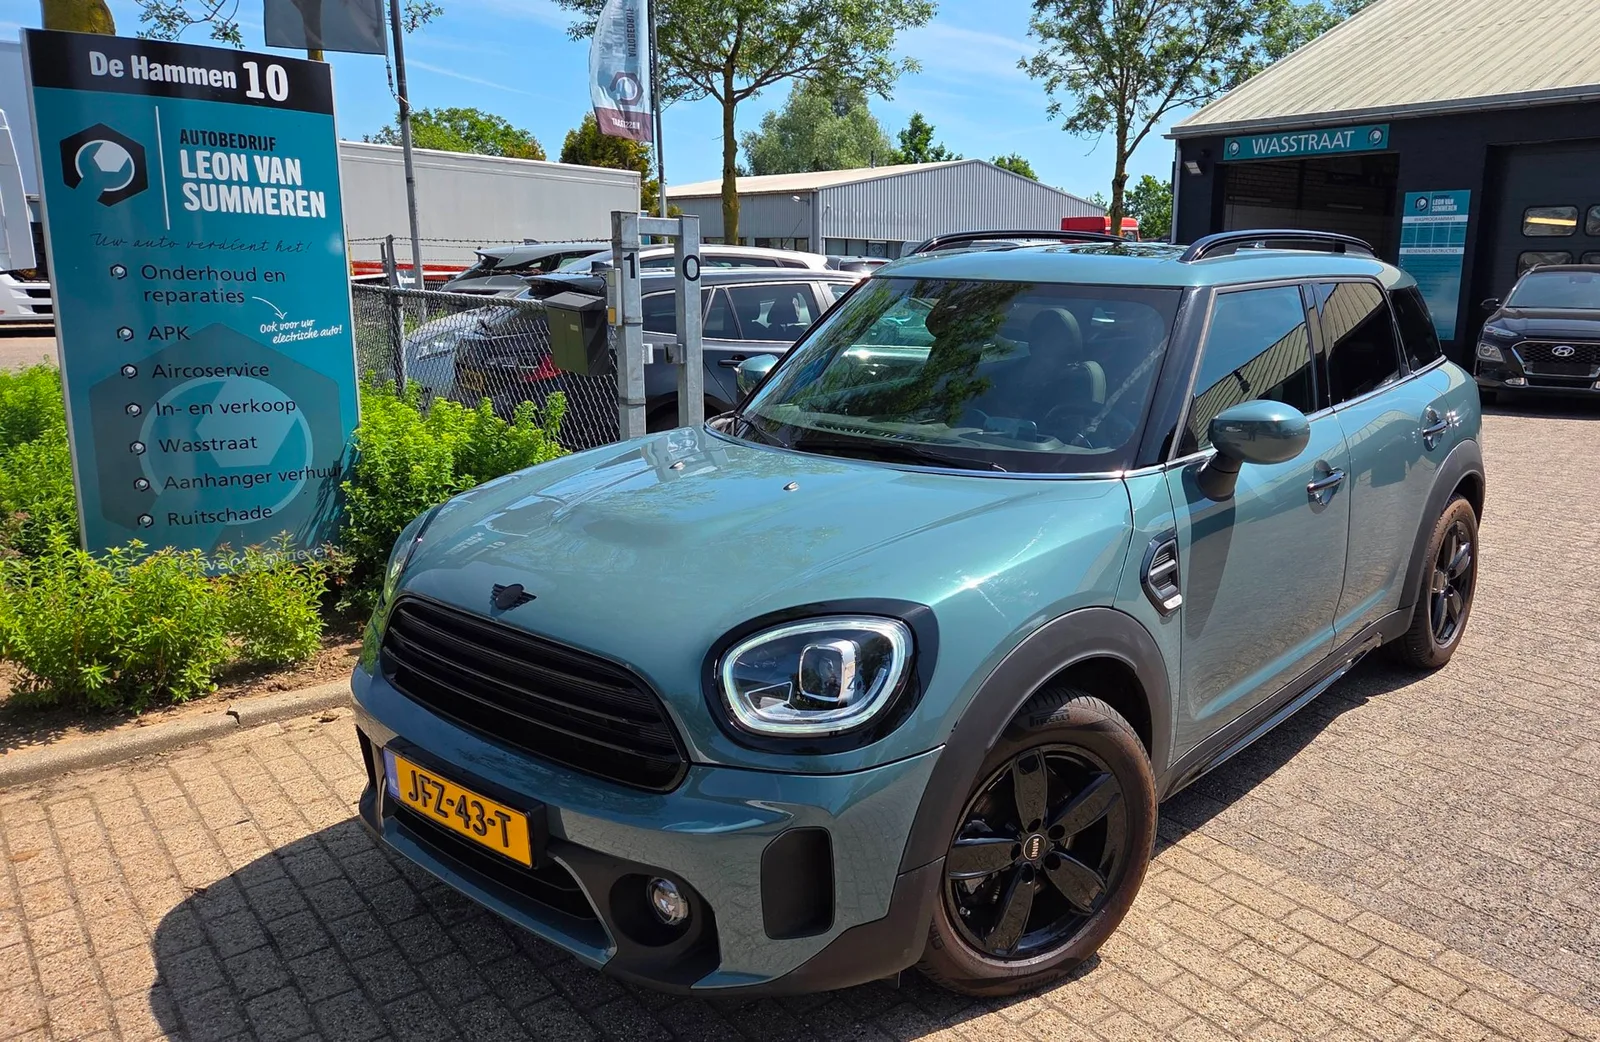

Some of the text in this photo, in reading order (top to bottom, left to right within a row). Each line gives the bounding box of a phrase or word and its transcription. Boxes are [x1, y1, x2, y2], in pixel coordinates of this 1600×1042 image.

[89, 51, 289, 101] De Hammen 10
[180, 129, 276, 152] AUTOBEDRIJF
[1252, 130, 1355, 155] WASSTRAAT
[180, 150, 302, 186] LEON VAN
[182, 183, 326, 218] SUMMEREN
[89, 233, 128, 247] Uw
[133, 235, 180, 248] auto
[275, 240, 312, 253] het!
[141, 265, 286, 282] Onderhoud en
[144, 288, 245, 306] reparaties
[148, 325, 191, 341] APK
[260, 319, 315, 334] Ook voor uw
[273, 324, 342, 344] electrische auto!
[152, 363, 270, 379] Aircoservice
[155, 399, 296, 417] In- en verkoop
[159, 436, 258, 453] Wasstraat
[163, 465, 344, 491] Aanhanger verhuur
[167, 506, 273, 527] Ruitschade
[408, 770, 511, 848] JFZ-43-T
[1031, 838, 1039, 857] MINI
